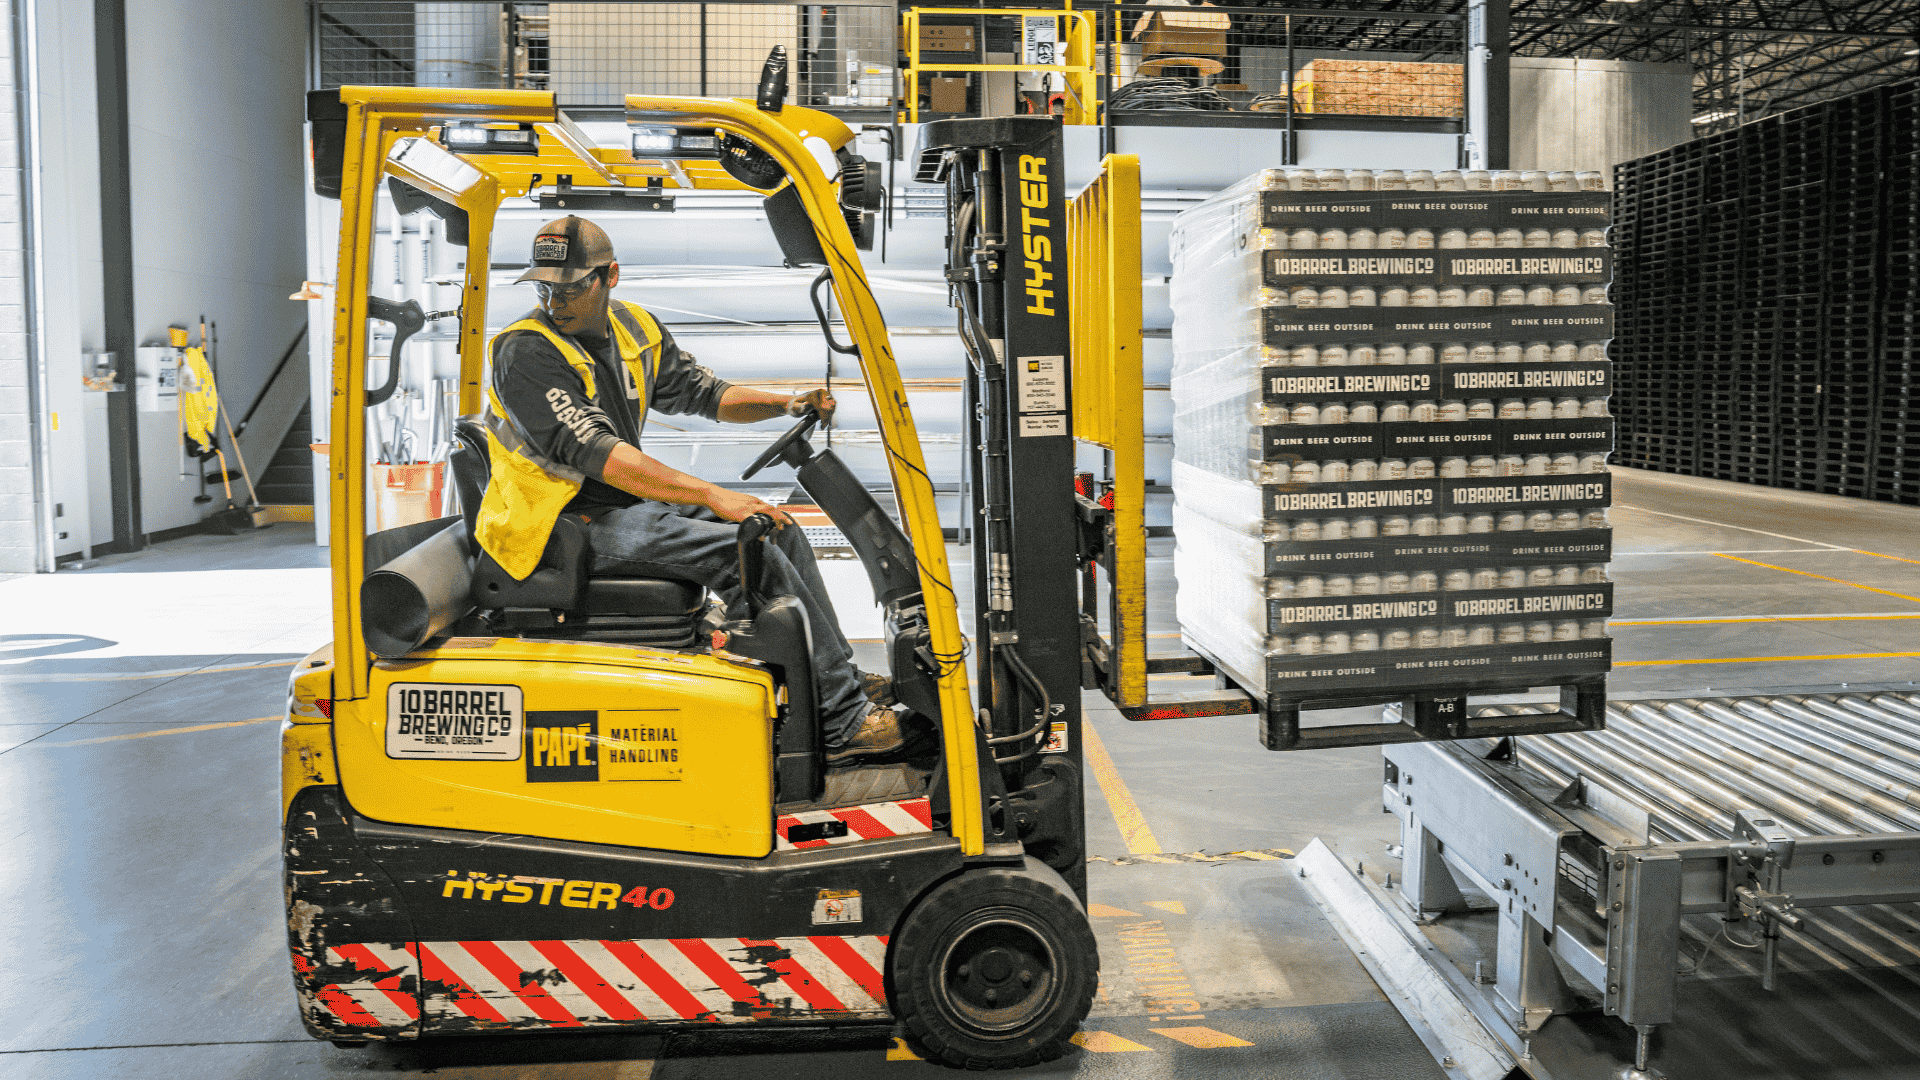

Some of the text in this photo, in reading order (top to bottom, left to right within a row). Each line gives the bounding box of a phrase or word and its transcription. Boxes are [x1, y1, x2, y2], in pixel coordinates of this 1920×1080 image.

[1027, 27, 1036, 51] LEDGE
[1391, 202, 1420, 210] DRINK
[1566, 206, 1605, 214] OUTSIDE
[1019, 154, 1055, 317] HYSTER
[1428, 322, 1449, 330] BEER
[1453, 322, 1492, 330] OUTSIDE
[1511, 318, 1539, 326] DRINK
[1542, 318, 1563, 326] BEER
[1273, 324, 1303, 332] DRINK
[1307, 324, 1329, 332] BEER
[1273, 438, 1303, 446] DRINK
[1332, 436, 1373, 444] OUTSIDE
[1395, 436, 1425, 444] DRINK
[1453, 434, 1492, 442] OUTSIDE
[1544, 432, 1565, 440] BEER
[1568, 432, 1606, 440] OUTSIDE
[1543, 546, 1564, 554] BEER
[1567, 544, 1605, 553] OUTSIDE
[1511, 654, 1539, 663] DRINK
[1566, 652, 1603, 660] OUTSIDE
[1395, 658, 1491, 670] DRINK BEER OUTSIDE
[1277, 670, 1307, 679] DRINK
[1336, 668, 1376, 676] OUTSIDE
[1438, 704, 1454, 713] A-B
[610, 728, 678, 742] MATERIAL
[425, 736, 484, 745] BEND, OREGON
[610, 749, 678, 763] HANDLING
[442, 869, 675, 910] HYSTER 40
